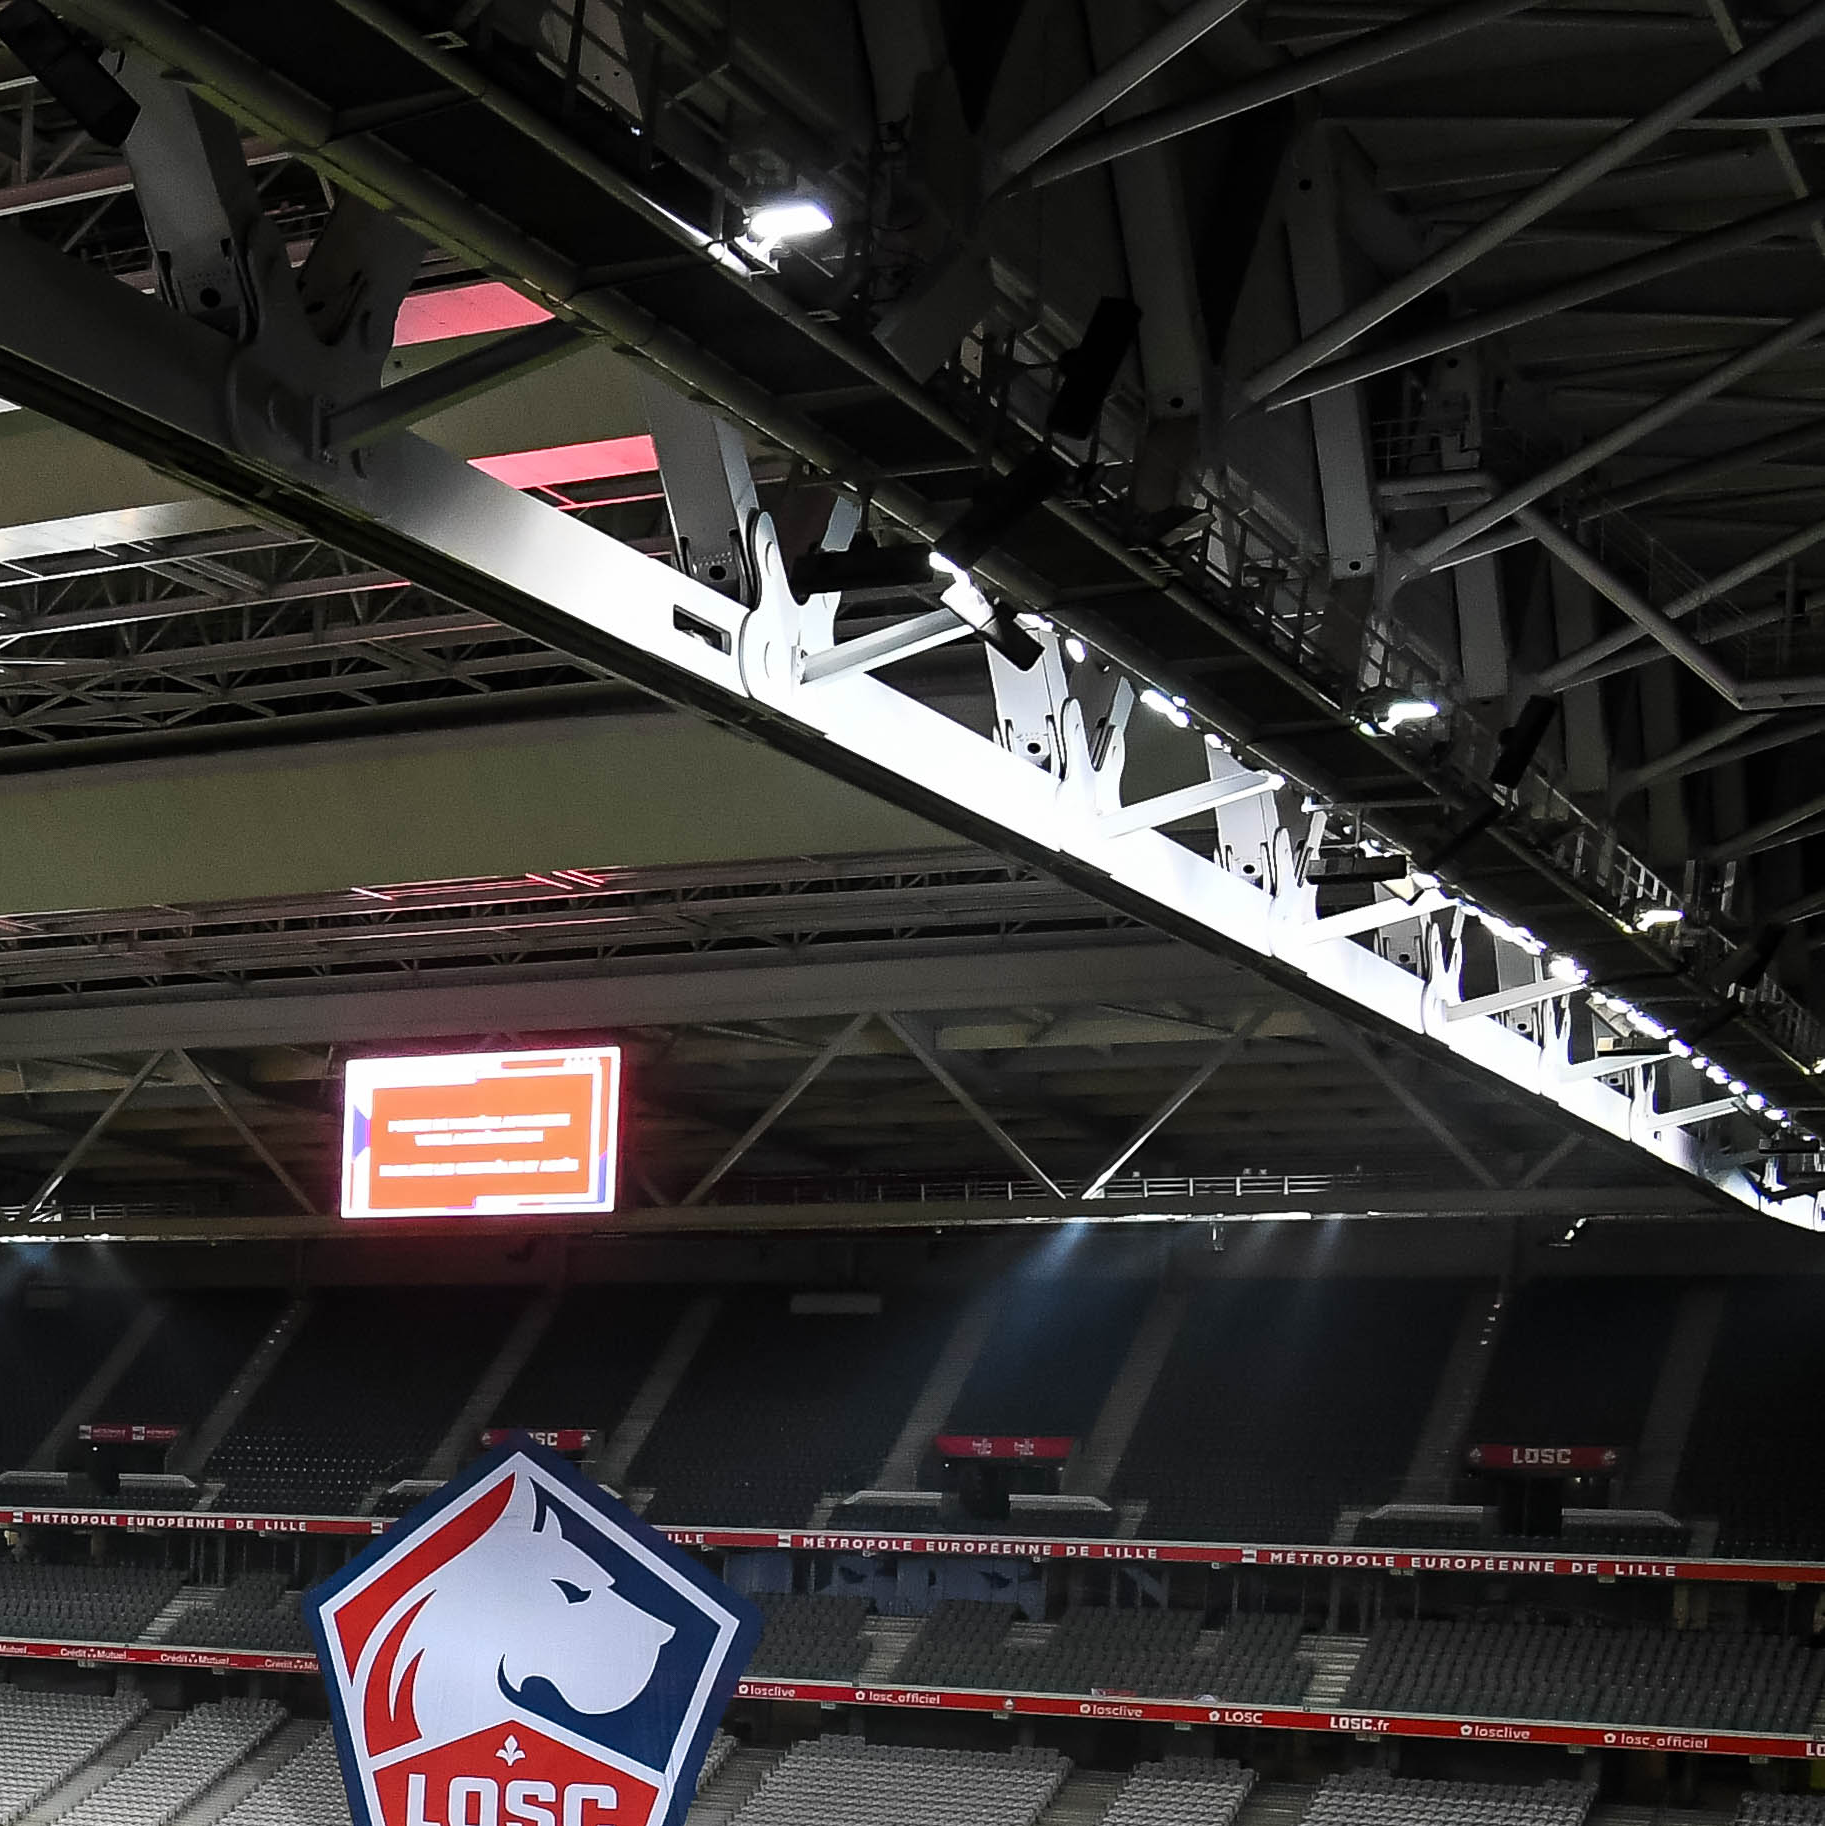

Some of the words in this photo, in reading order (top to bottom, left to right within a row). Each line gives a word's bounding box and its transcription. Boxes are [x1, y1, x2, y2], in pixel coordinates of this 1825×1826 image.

[1512, 1448, 1571, 1464] LOSC
[128, 1515, 224, 1528] EUROPÉENNE
[236, 1520, 253, 1530] DE
[265, 1521, 305, 1530] LILLE
[668, 1533, 703, 1543] ILLE
[804, 1534, 911, 1551] MÉTROPOLE
[927, 1538, 1050, 1555] EUROPÉENNE
[1067, 1546, 1088, 1557] DE
[1105, 1547, 1156, 1558] LILLE
[1271, 1552, 1394, 1566] MÉTROPOLE
[1412, 1554, 1554, 1572] EUROPÉENNE
[1572, 1563, 1597, 1573] DE
[1615, 1564, 1675, 1576] LILLE
